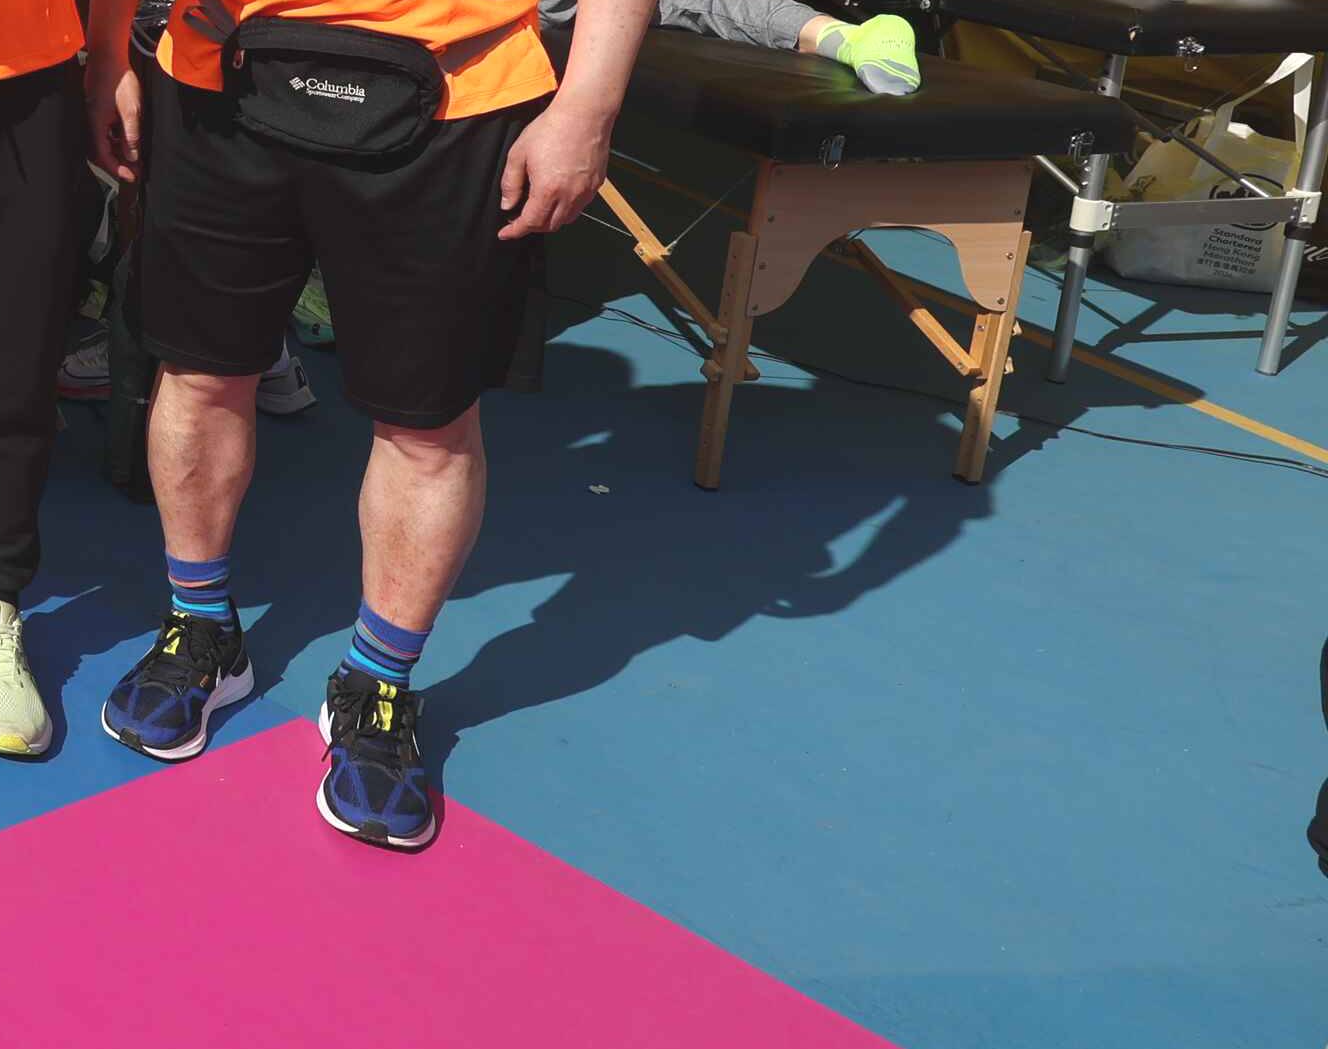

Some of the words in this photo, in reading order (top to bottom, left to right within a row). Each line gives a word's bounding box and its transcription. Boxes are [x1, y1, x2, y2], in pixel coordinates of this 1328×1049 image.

[305, 78, 366, 97] Columbia
[1208, 235, 1262, 253] Chartered
[1213, 227, 1264, 246] Standard
[1202, 251, 1256, 268] Marathon
